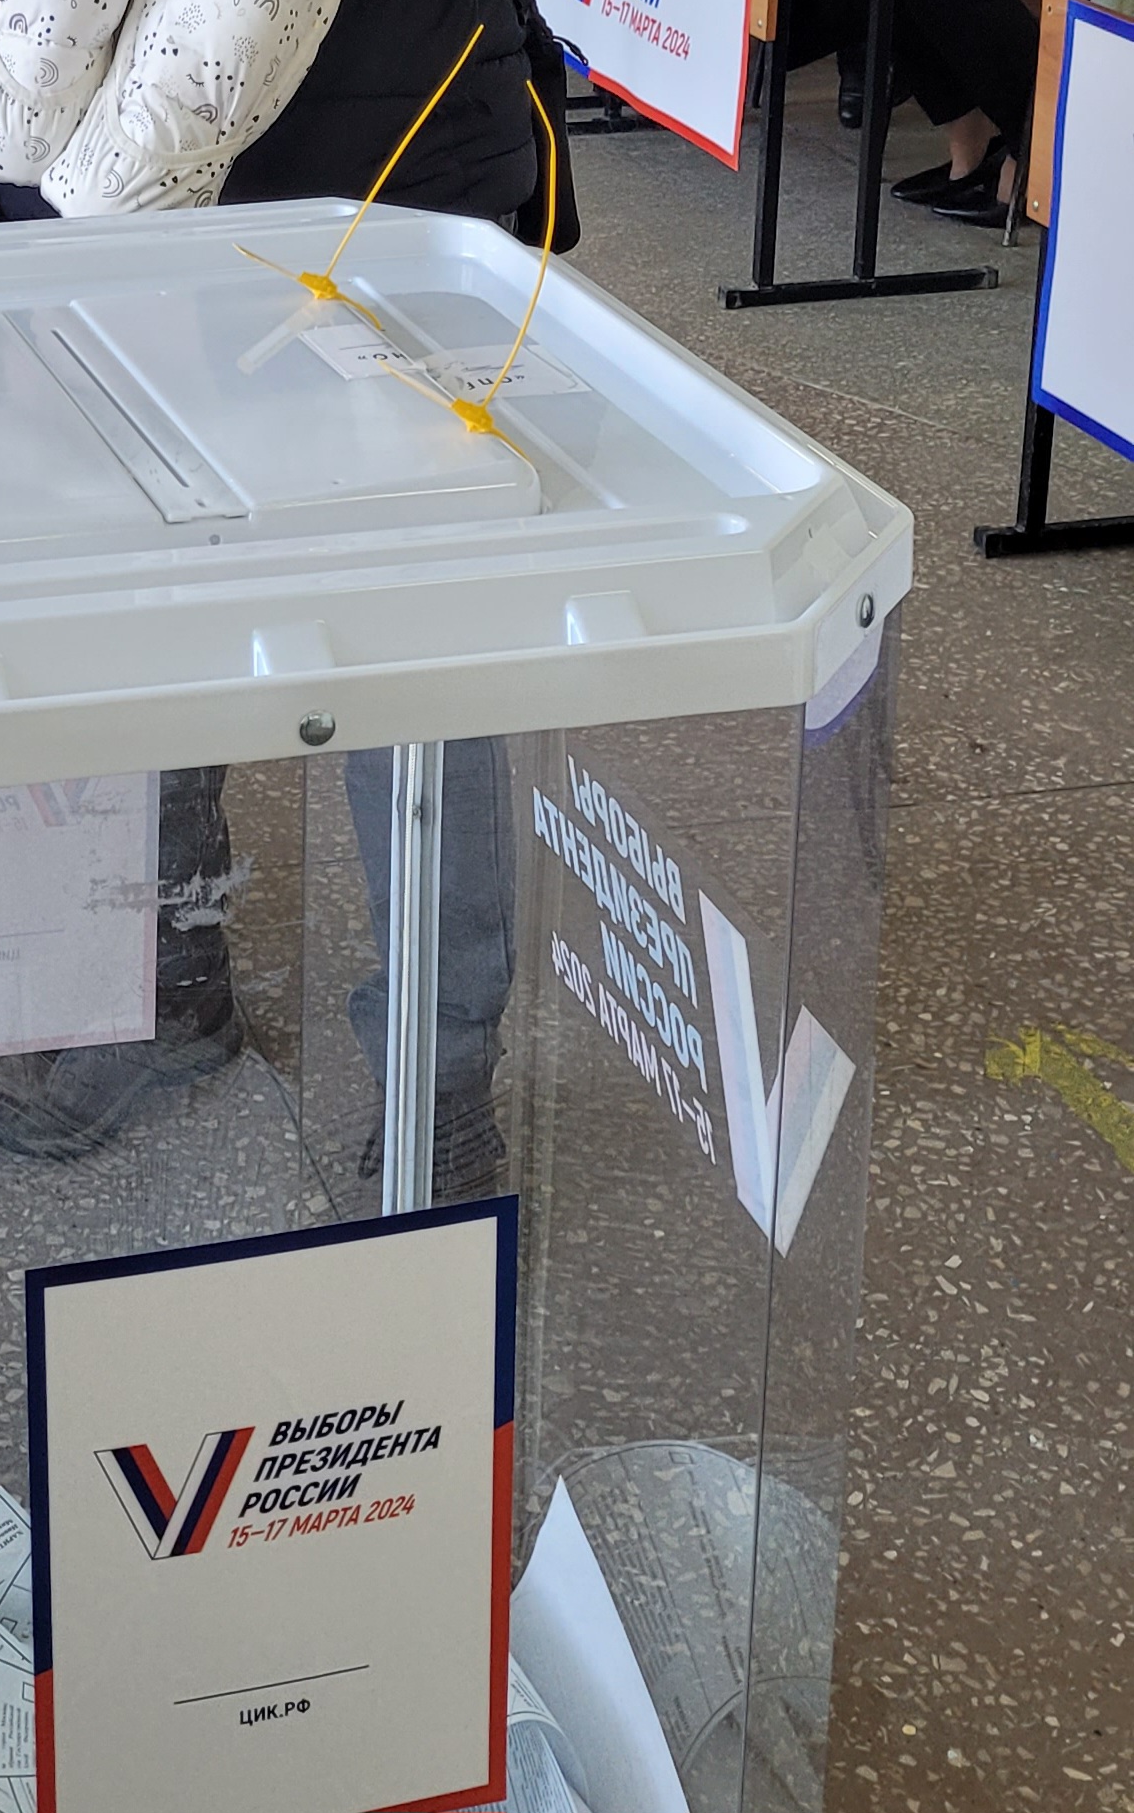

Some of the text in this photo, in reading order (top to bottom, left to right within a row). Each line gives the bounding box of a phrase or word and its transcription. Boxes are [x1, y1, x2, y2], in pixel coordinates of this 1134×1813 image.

[629, 7, 662, 46] МАРТА
[661, 26, 691, 61] 2024
[268, 1399, 406, 1448] ВЫБОРЫ
[253, 1425, 443, 1483] ПРЕЗИДЕНТА
[238, 1472, 363, 1519] РОССИИ
[288, 1504, 362, 1537] МАРТА
[363, 1493, 416, 1523] 2024
[239, 1698, 312, 1727] ЦИК.РФ
